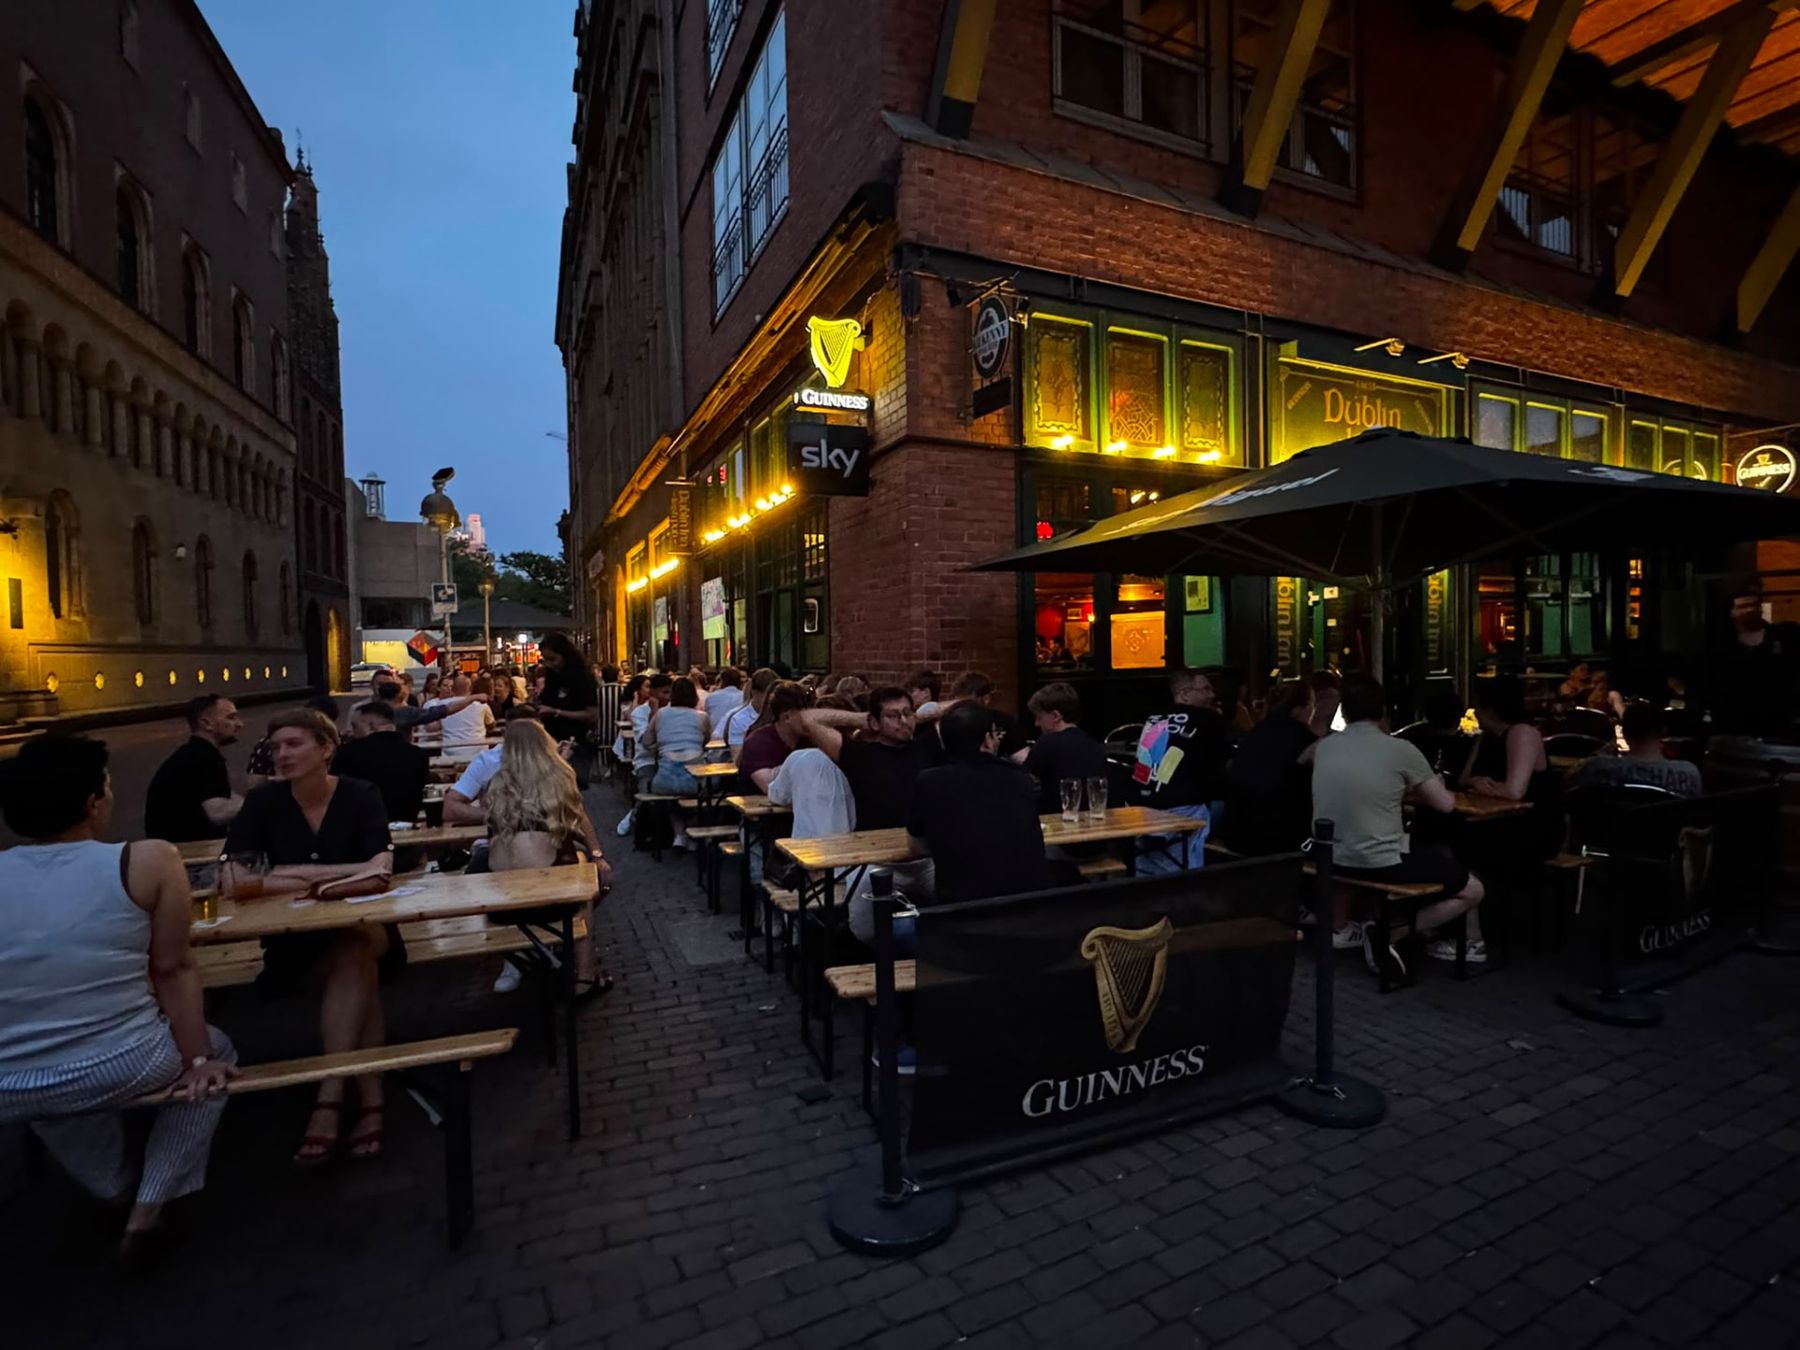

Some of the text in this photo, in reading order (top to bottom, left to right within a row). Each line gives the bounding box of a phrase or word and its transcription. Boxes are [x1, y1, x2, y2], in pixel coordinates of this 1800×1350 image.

[801, 388, 870, 410] GUINNESS
[1323, 388, 1402, 430] Dublin
[800, 438, 861, 478] sky
[1021, 1044, 1208, 1118] GUINNESS
